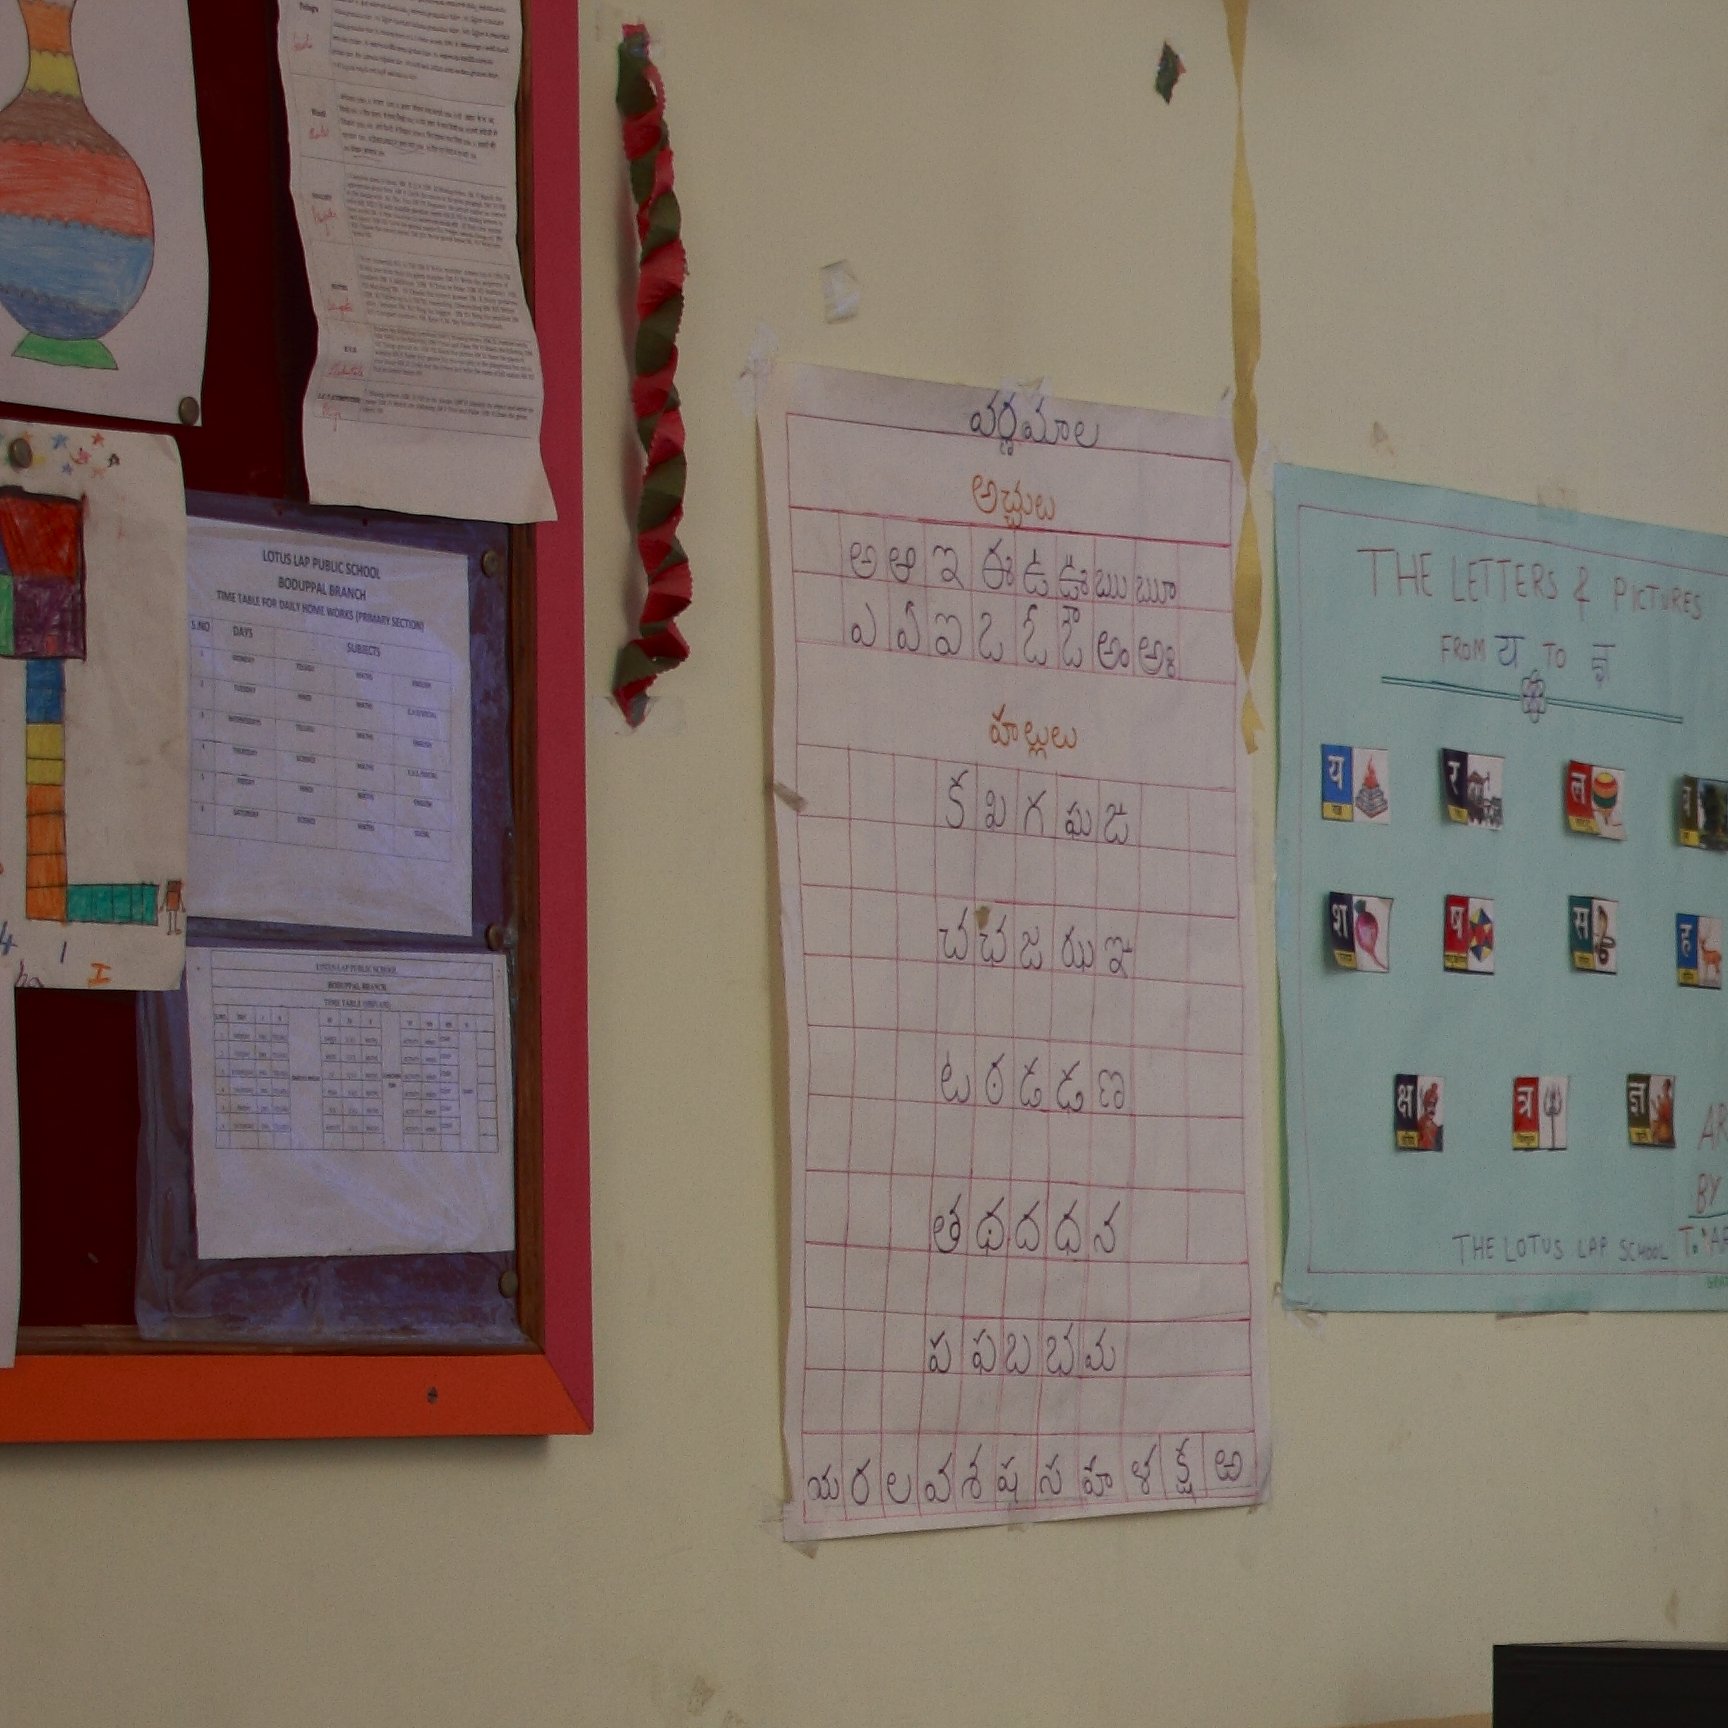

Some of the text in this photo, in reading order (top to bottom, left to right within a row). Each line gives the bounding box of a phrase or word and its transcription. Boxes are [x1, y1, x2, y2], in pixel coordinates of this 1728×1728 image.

[263, 550, 381, 580] LOTUS LAP PUBLIC SCHOOL
[278, 576, 367, 602] BODUPPAL BRANCH
[1357, 548, 1433, 599] THE
[1452, 556, 1558, 603] LETTERS
[1613, 575, 1703, 621] PICTURES
[217, 590, 425, 633] TIME TABLE FOR DAILY HOME WORKS (PRIMARY SECTION)
[232, 625, 254, 639] DAYS
[346, 642, 381, 657] SUBJECTS
[1440, 634, 1487, 668] FROM
[1542, 642, 1567, 669] TO
[1327, 754, 1345, 791] य
[1330, 903, 1349, 939] श
[1573, 905, 1590, 939] स
[1695, 1172, 1722, 1215] BY
[1452, 1234, 1494, 1266] THE
[1503, 1234, 1565, 1264] LOTUS
[1577, 1239, 1607, 1261] LAP
